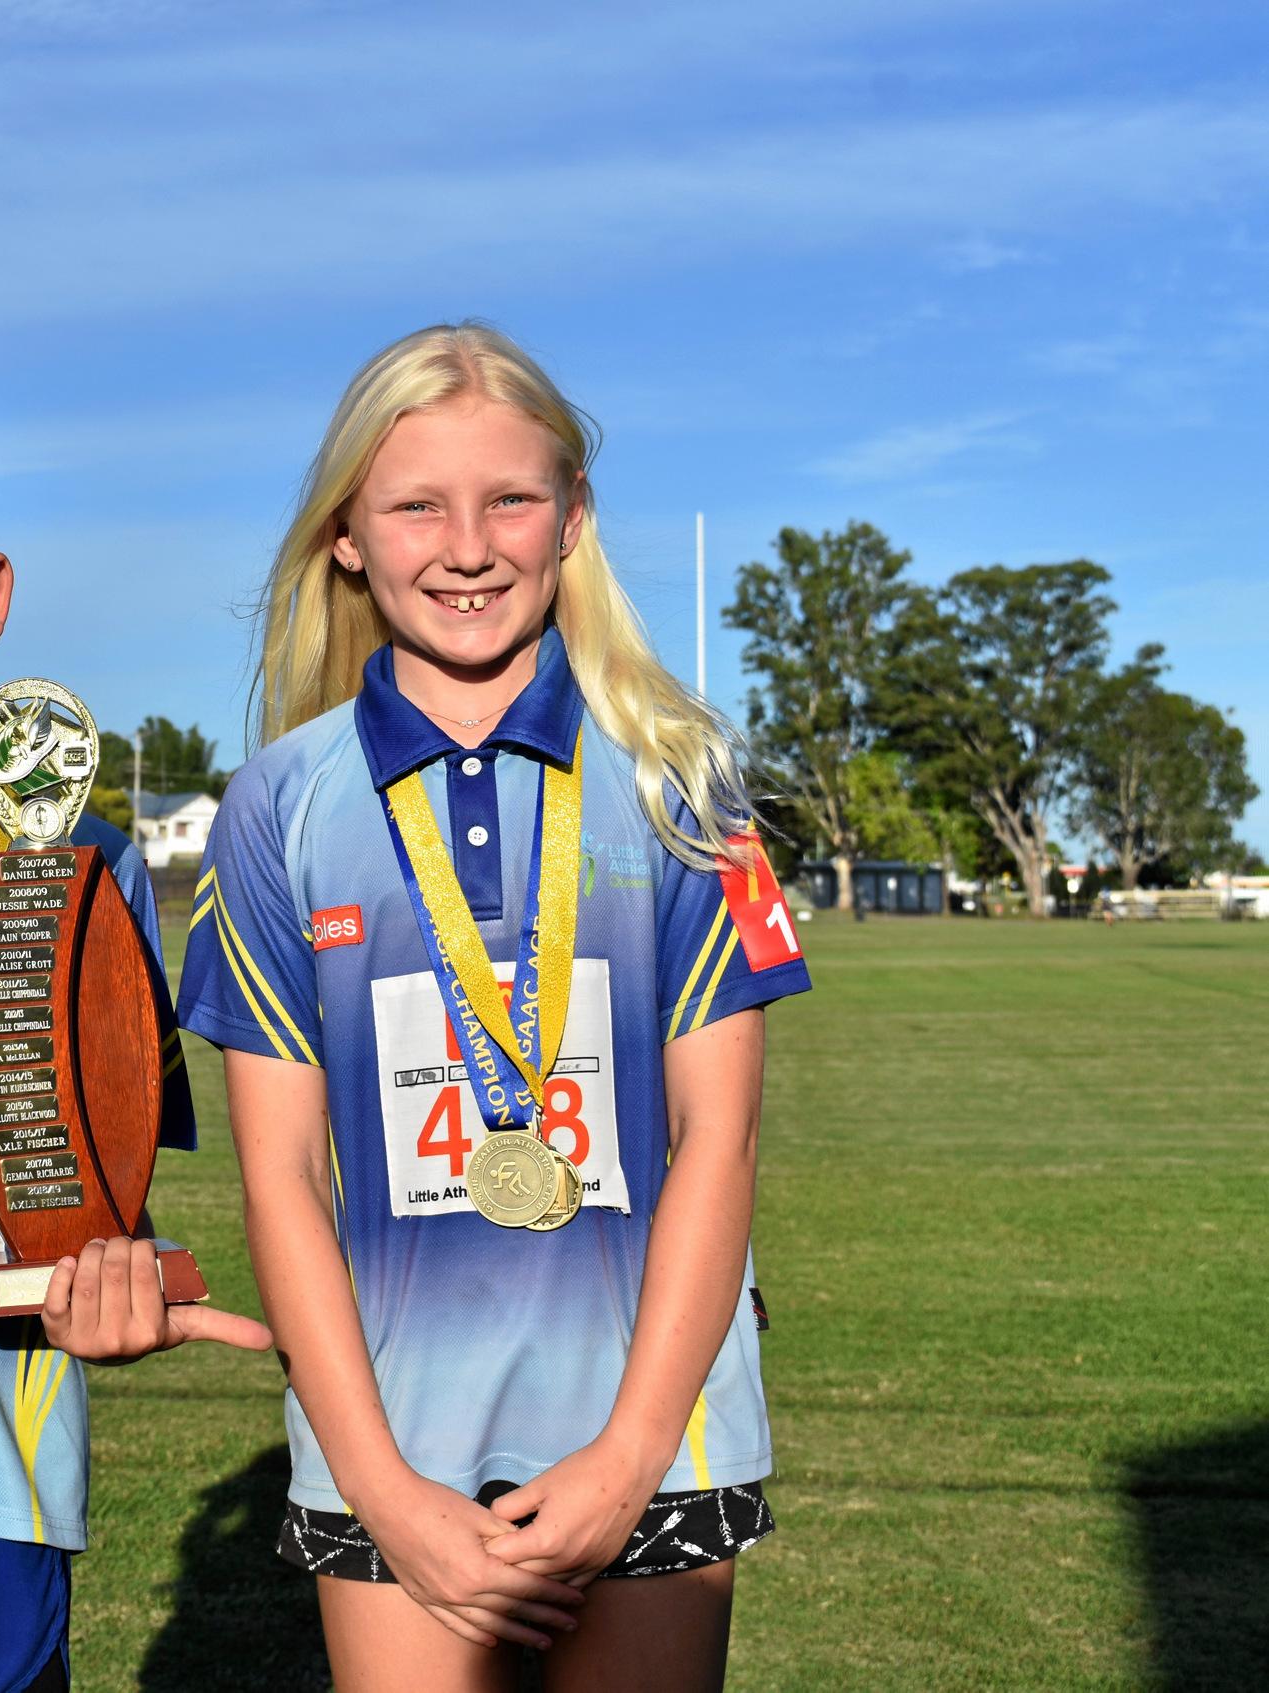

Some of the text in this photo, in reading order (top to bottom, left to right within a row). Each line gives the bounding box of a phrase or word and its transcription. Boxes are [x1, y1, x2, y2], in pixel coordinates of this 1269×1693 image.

[19, 857, 57, 869] 2007/08
[3, 868, 74, 881] DANIEL GREEN
[9, 887, 48, 898] 2008/09
[33, 899, 63, 910] WADE
[2, 918, 39, 930] 2009/10
[314, 917, 357, 942] oles
[765, 901, 799, 954] 1
[20, 930, 52, 941] COOPER
[0, 950, 32, 960] 2010/11
[26, 959, 53, 970] GROTT
[11, 988, 47, 999] CHIPPINDALL
[4, 1009, 24, 1019] 2012/13
[517, 980, 539, 1058] GAAC
[13, 1020, 51, 1031] CHIPPINDALL
[2, 1043, 29, 1052] 2013/14
[451, 979, 515, 1127] CHAMPION
[6, 1052, 41, 1062] McLELLAN
[0, 1072, 33, 1083] 2014/15
[10, 1081, 53, 1094] KUERSCHNER
[5, 1101, 33, 1112] 2015/16
[20, 1110, 56, 1121] BLACKWOOD
[417, 1078, 591, 1177] 48
[13, 1128, 47, 1140] 2016/17
[26, 1137, 67, 1149] FISCHER
[25, 1158, 53, 1168] 2017/18
[473, 1138, 511, 1172] AMATEUR
[513, 1138, 554, 1182] ATHLETICS
[6, 1167, 74, 1182] GEMMA RICHARDS
[27, 1185, 62, 1196] 2018/19
[408, 1189, 439, 1203] Little
[10, 1196, 81, 1211] AXLE FISCHER
